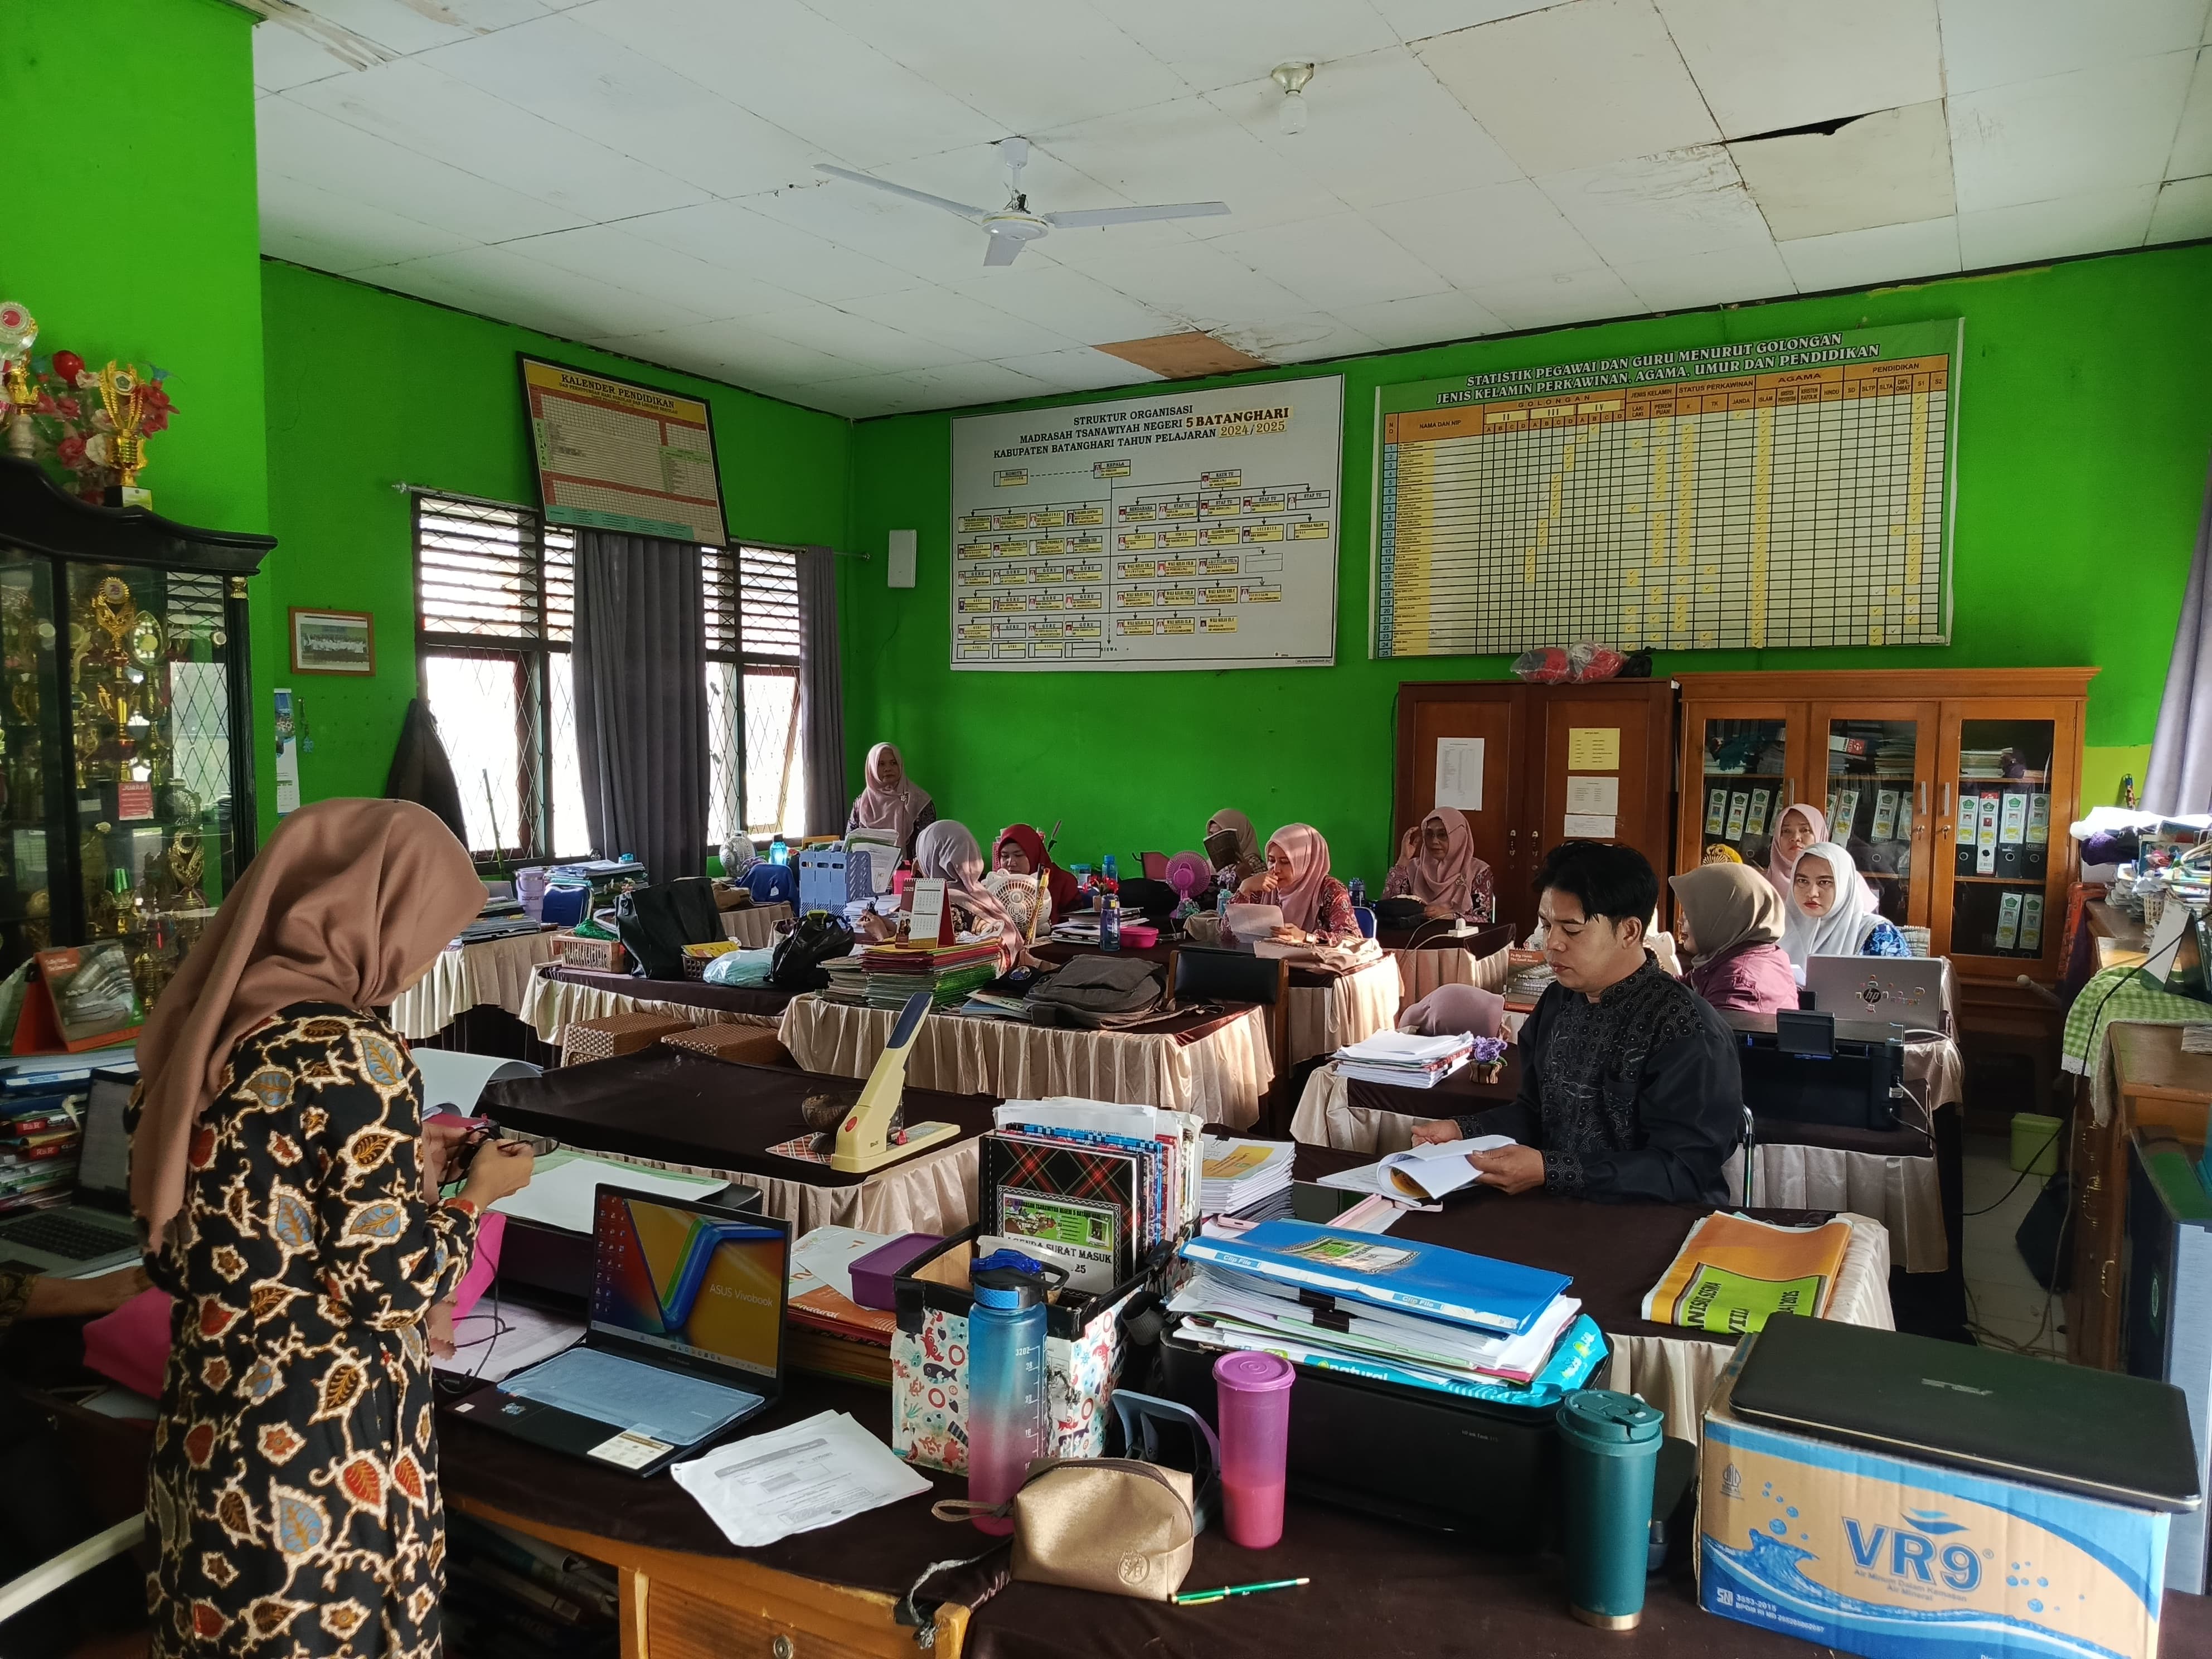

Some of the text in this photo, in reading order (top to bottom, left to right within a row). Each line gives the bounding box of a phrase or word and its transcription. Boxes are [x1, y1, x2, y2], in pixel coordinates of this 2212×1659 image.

[1467, 333, 1842, 386] STATISTIK PEGAWAI DAN GURU MENURUT GOLONGAN
[1873, 363, 1919, 373] PENDIDIKAN
[1437, 345, 1879, 404] JENIS KELAMIN PERKAWINAN, AGAMA, UMUR DAN PENDIDIKAN
[1778, 373, 1822, 382] AGAMA
[561, 374, 615, 394] KALENDER
[619, 389, 675, 409] PENDIDIKAN
[1707, 380, 1753, 390] PERKAWINAN
[1074, 405, 1193, 426] STRUKTUR ORGANISASI
[1020, 408, 1289, 443] MADRASAH TSANAWIYAH NEGERI 5 BATANGHARI
[993, 421, 1285, 458] KABUPATEN BATANGHARI TAHUN PELAJARAN 2024/2025
[1864, 987, 1881, 1003] hp
[1046, 1244, 1112, 1264] SURAT MASUK
[1223, 1255, 1236, 1264] Clip
[1074, 1264, 1086, 1273] 25
[710, 1284, 773, 1307] ASUS Vivobook
[1402, 1296, 1417, 1304] Clip
[799, 1304, 841, 1319] natural
[1841, 1516, 1982, 1592] VR9
[1855, 1569, 1967, 1602] Air Minum Dalam Kemasan
[1887, 1583, 1933, 1602] Air Mineral
[1717, 1587, 1733, 1606] SNI
